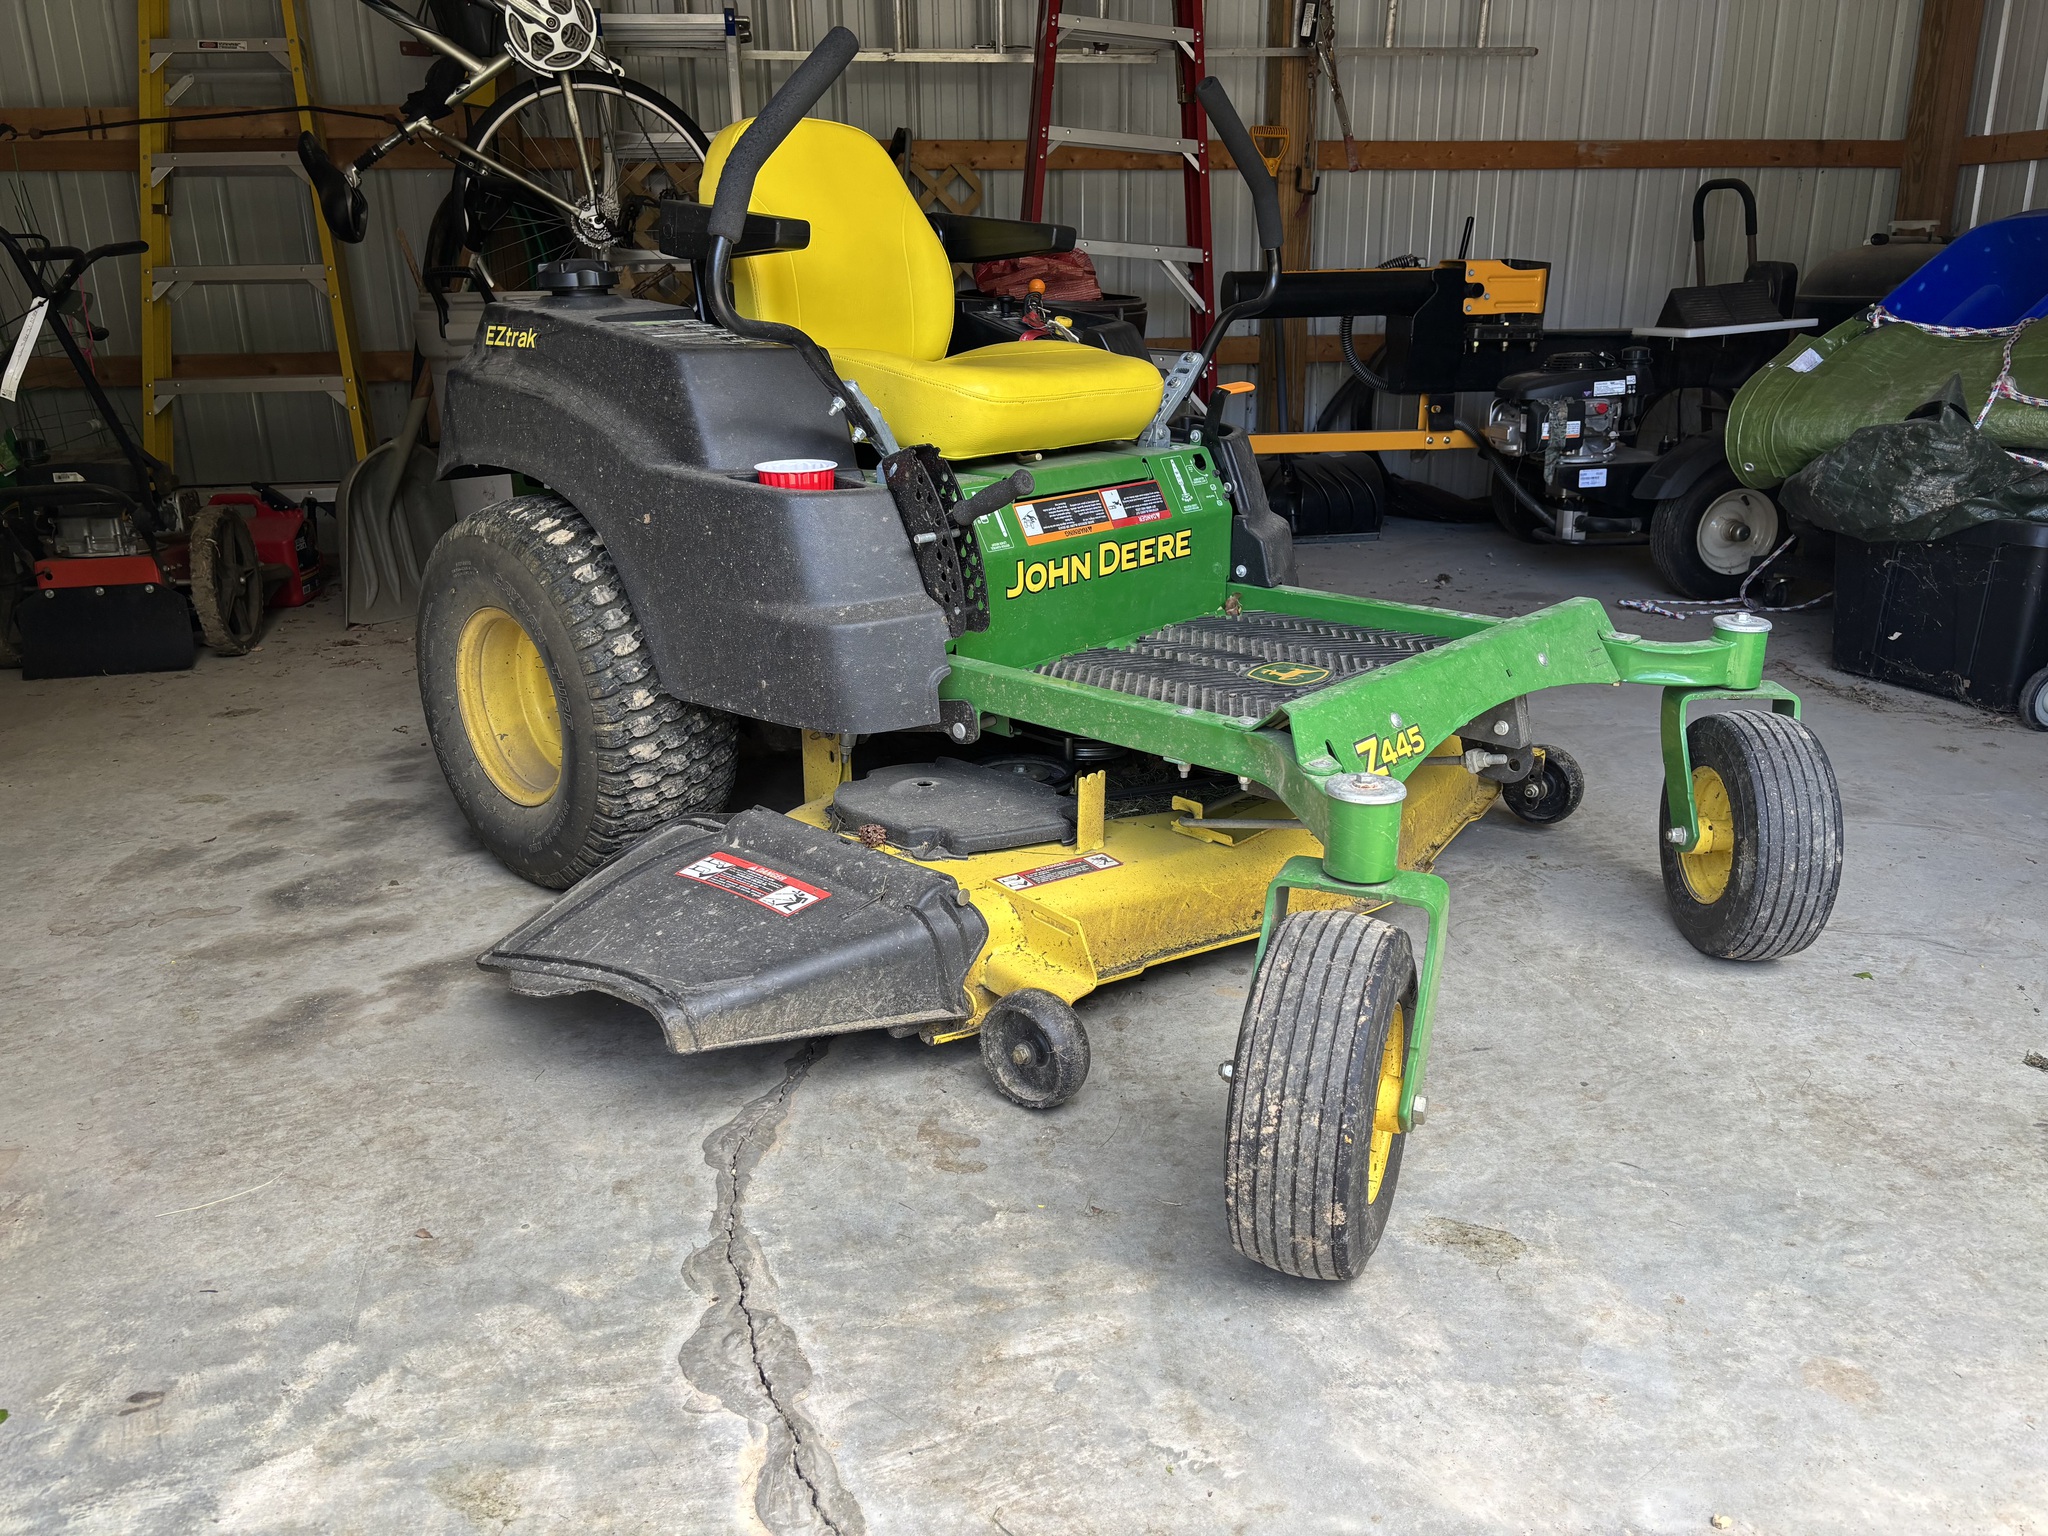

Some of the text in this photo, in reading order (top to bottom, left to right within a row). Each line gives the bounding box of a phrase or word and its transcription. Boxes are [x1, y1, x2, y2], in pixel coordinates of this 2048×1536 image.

[485, 325, 538, 349] EZtrak
[1064, 526, 1088, 537] WARNING
[1005, 528, 1192, 600] JOHN DEERE
[492, 572, 574, 731] CAYMAN TURF
[1353, 723, 1425, 776] Z445
[755, 868, 787, 881] DANGER
